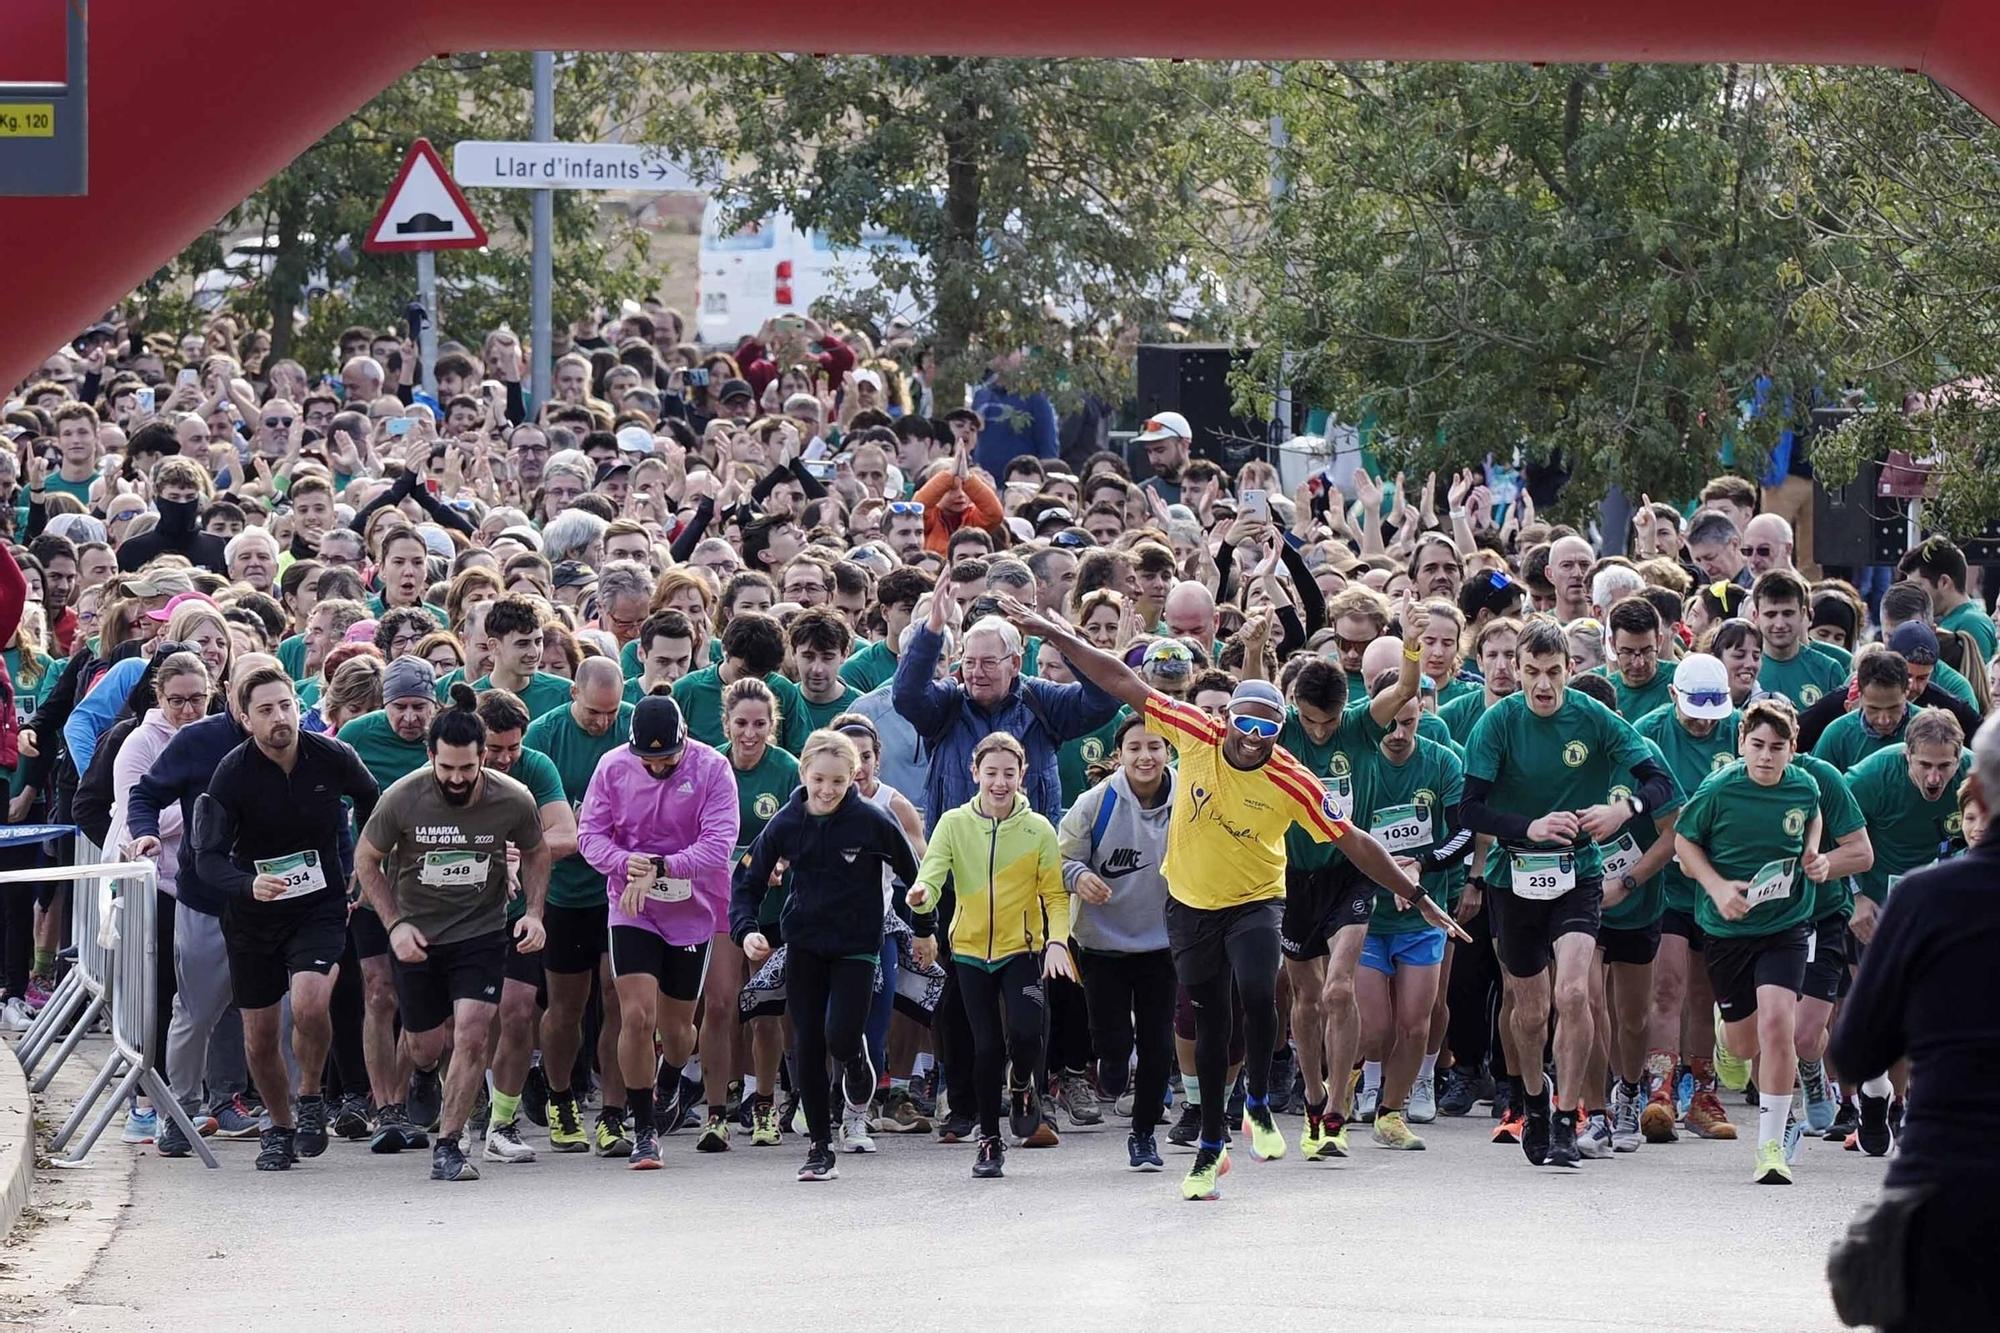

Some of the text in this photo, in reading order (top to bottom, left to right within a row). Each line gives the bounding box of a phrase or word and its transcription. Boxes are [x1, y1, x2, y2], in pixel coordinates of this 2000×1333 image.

[0, 113, 49, 132] Kg. 120
[495, 157, 640, 179] Llar d'infants
[415, 826, 460, 835] LA MARXA
[1383, 825, 1420, 841] 1030
[416, 835, 437, 844] DELS
[438, 835, 450, 844] 40
[474, 835, 495, 844] 2023
[1108, 848, 1143, 868] NIKE
[442, 866, 471, 876] 348
[1529, 876, 1557, 888] 239
